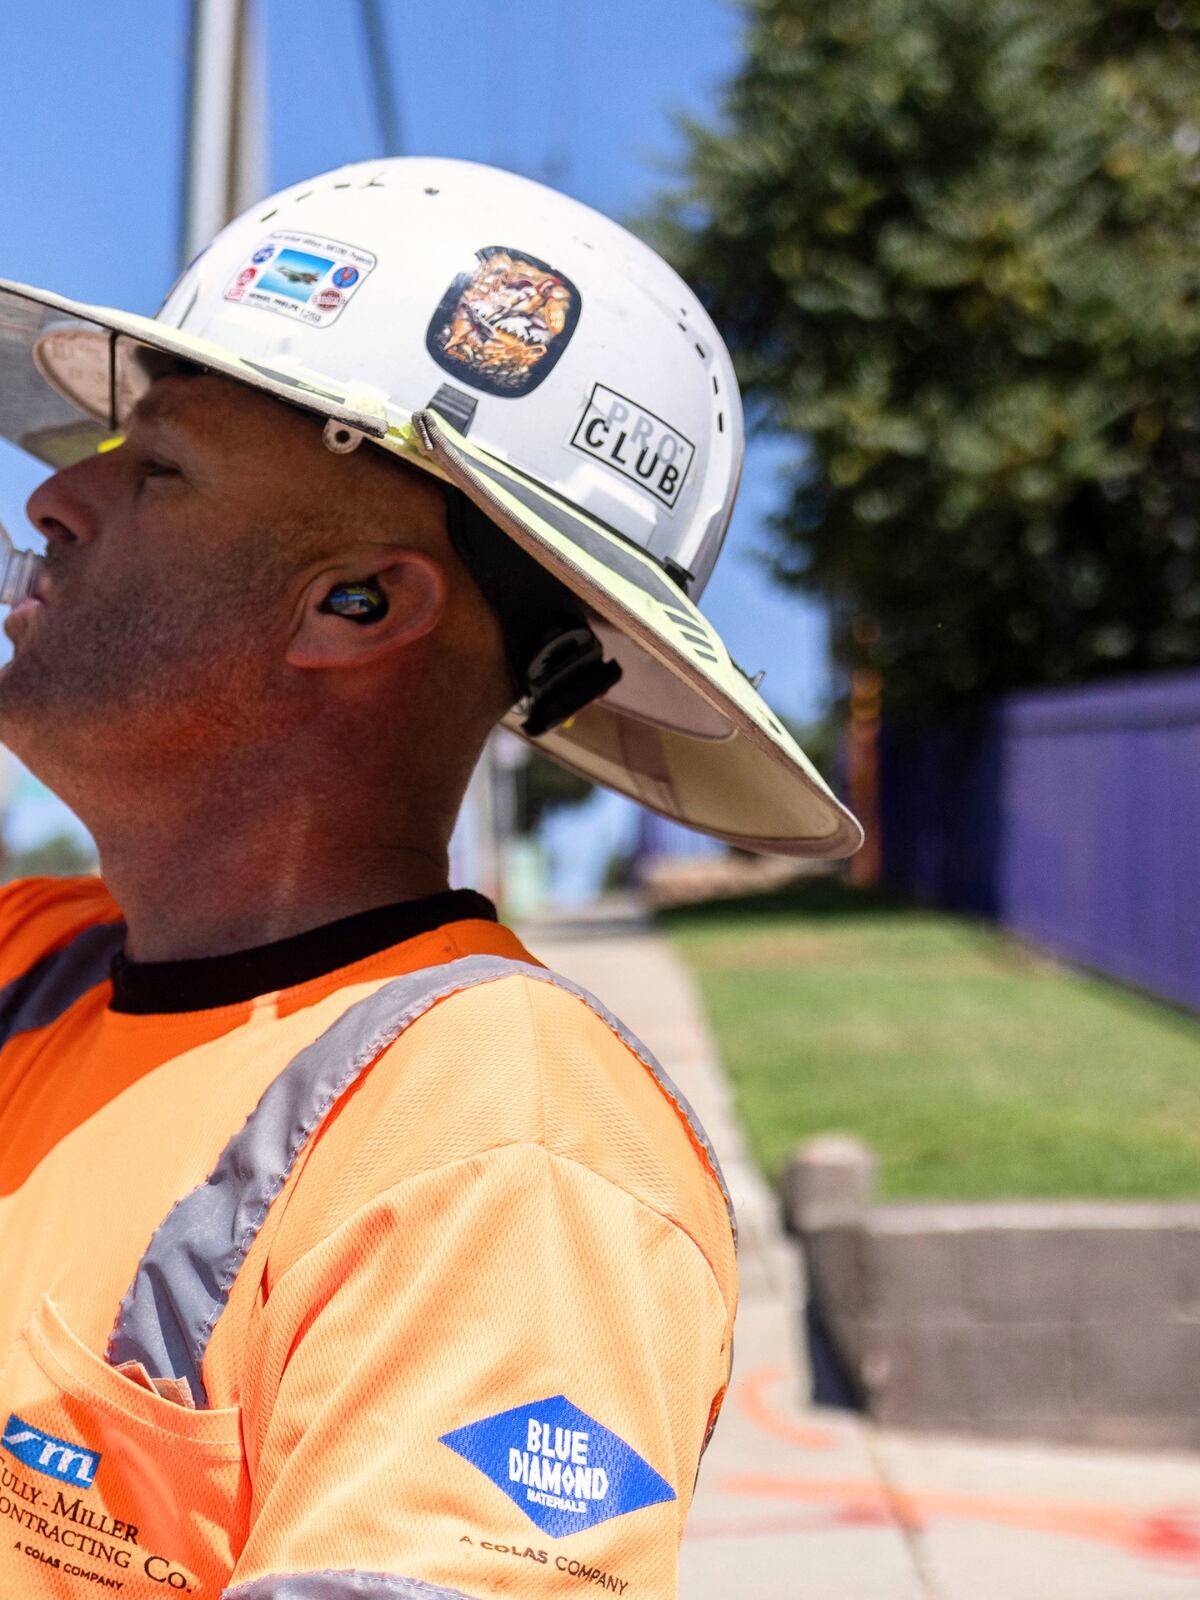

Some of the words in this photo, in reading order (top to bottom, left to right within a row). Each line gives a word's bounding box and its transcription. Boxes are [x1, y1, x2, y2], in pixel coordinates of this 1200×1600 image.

[585, 417, 679, 495] CLUB
[606, 400, 678, 465] PRO
[527, 1418, 590, 1466] BLUE
[508, 1447, 609, 1501] DIAMOND
[526, 1488, 587, 1514] MATERIALS
[14, 1541, 21, 1550] A
[25, 1546, 60, 1569] COLAS
[63, 1563, 124, 1591] COMPANY
[459, 1535, 474, 1546] A
[480, 1541, 548, 1565] COLAS
[555, 1556, 629, 1596] COMPANY
